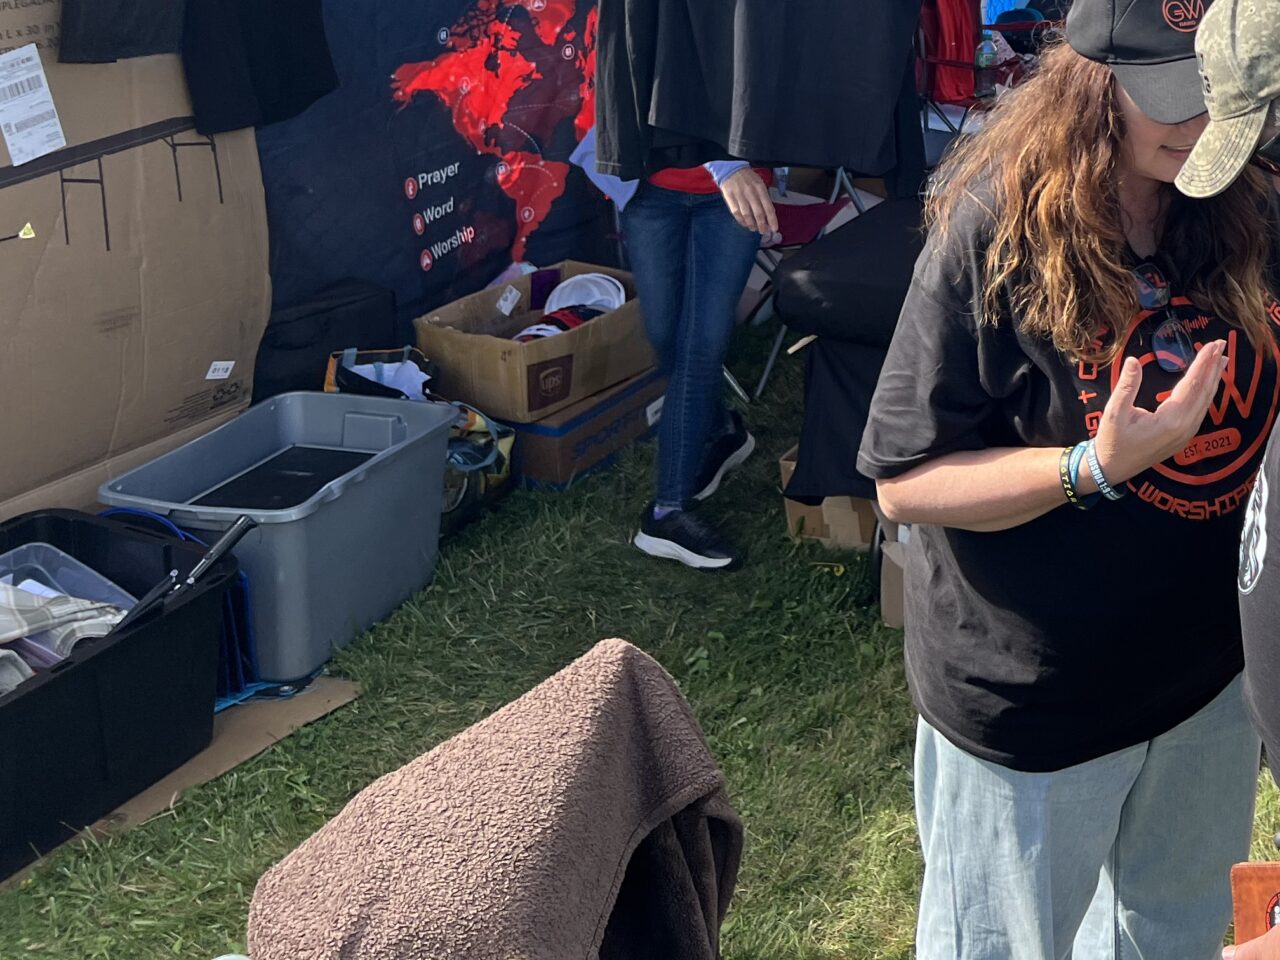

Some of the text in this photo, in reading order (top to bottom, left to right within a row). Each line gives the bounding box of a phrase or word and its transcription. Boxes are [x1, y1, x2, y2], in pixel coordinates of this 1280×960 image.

[418, 161, 460, 190] Prayer
[423, 196, 454, 225] Word
[431, 226, 475, 260] Worship
[1184, 436, 1232, 459] EST. 2021
[1088, 456, 1105, 484] JOSHUA
[1138, 480, 1248, 521] WORSHIP
